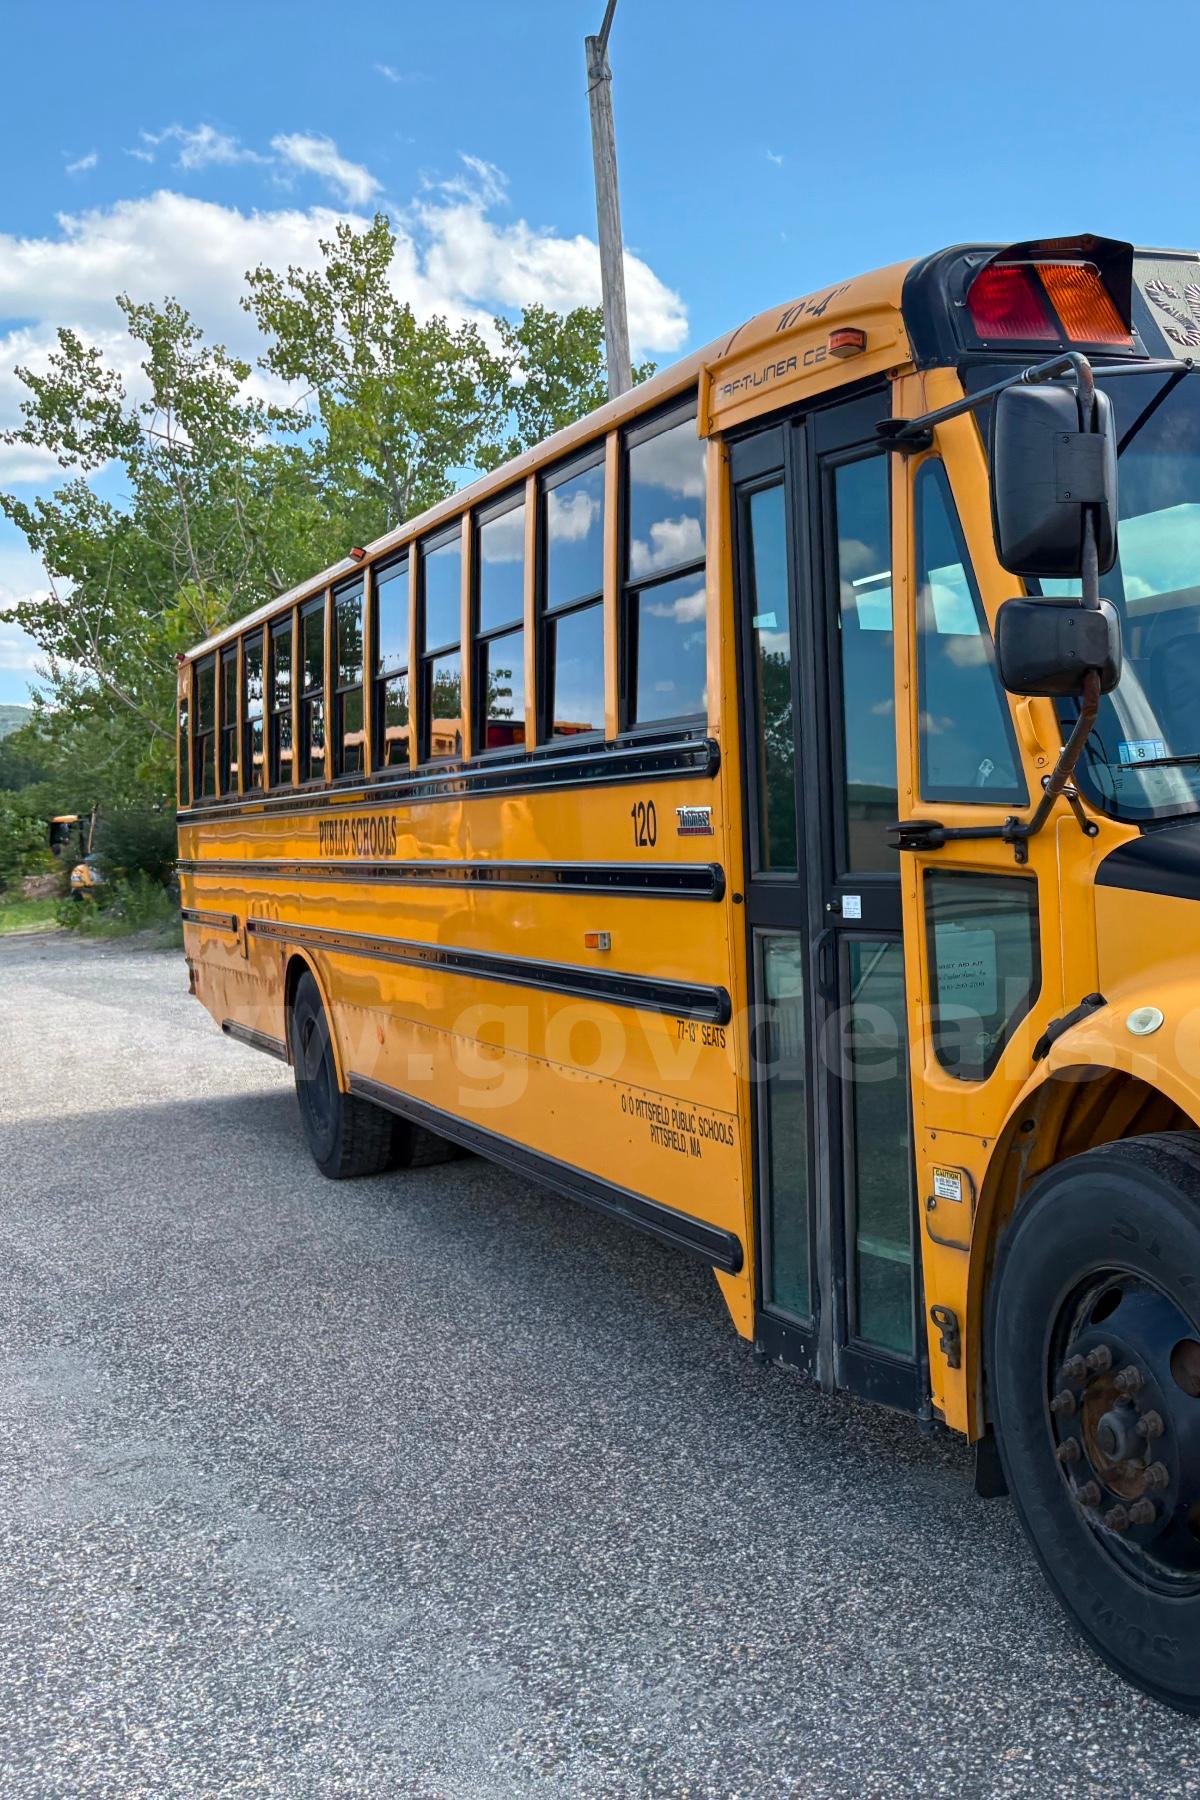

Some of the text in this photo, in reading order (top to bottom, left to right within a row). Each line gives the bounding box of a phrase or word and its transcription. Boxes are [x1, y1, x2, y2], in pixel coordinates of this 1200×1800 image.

[803, 345, 828, 367] C2
[1138, 748, 1146, 759] 8
[631, 799, 657, 847] 120
[675, 805, 713, 828] Thomas
[319, 815, 397, 857] PUBLIC SCHOOLS
[701, 1024, 726, 1049] SEATS
[635, 1098, 669, 1126] PITTSFIELD
[671, 1108, 696, 1134] PUBLIC
[698, 1116, 734, 1146] SCHOOLS
[650, 1123, 702, 1159] PITTSFIELD, MA
[935, 1169, 959, 1180] CAUTION
